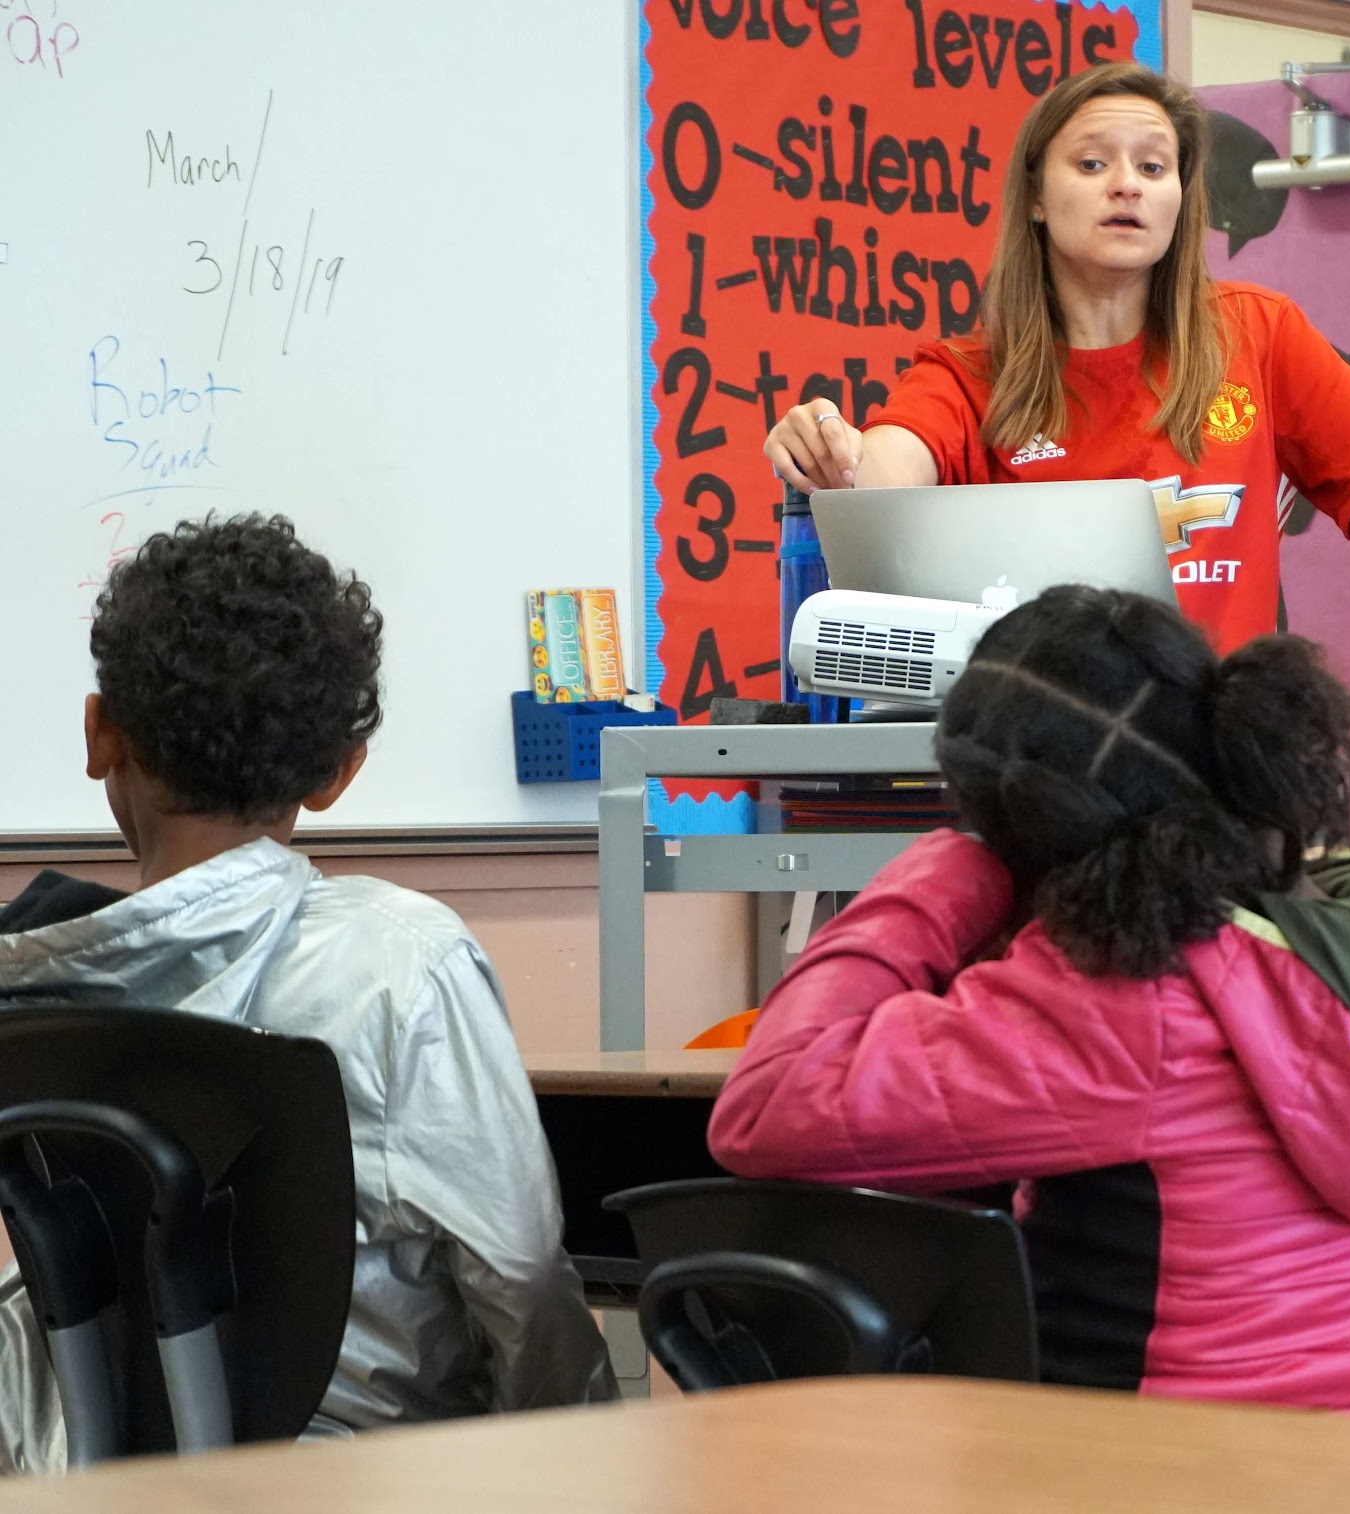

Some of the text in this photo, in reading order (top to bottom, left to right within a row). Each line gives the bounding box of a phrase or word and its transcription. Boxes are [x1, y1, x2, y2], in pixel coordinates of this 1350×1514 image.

[183, 208, 344, 362] 3/18/19
[681, 216, 983, 340] 1-whisp
[90, 335, 241, 426] Robot
[1010, 446, 1067, 466] adidas
[1209, 425, 1246, 438] UNITED
